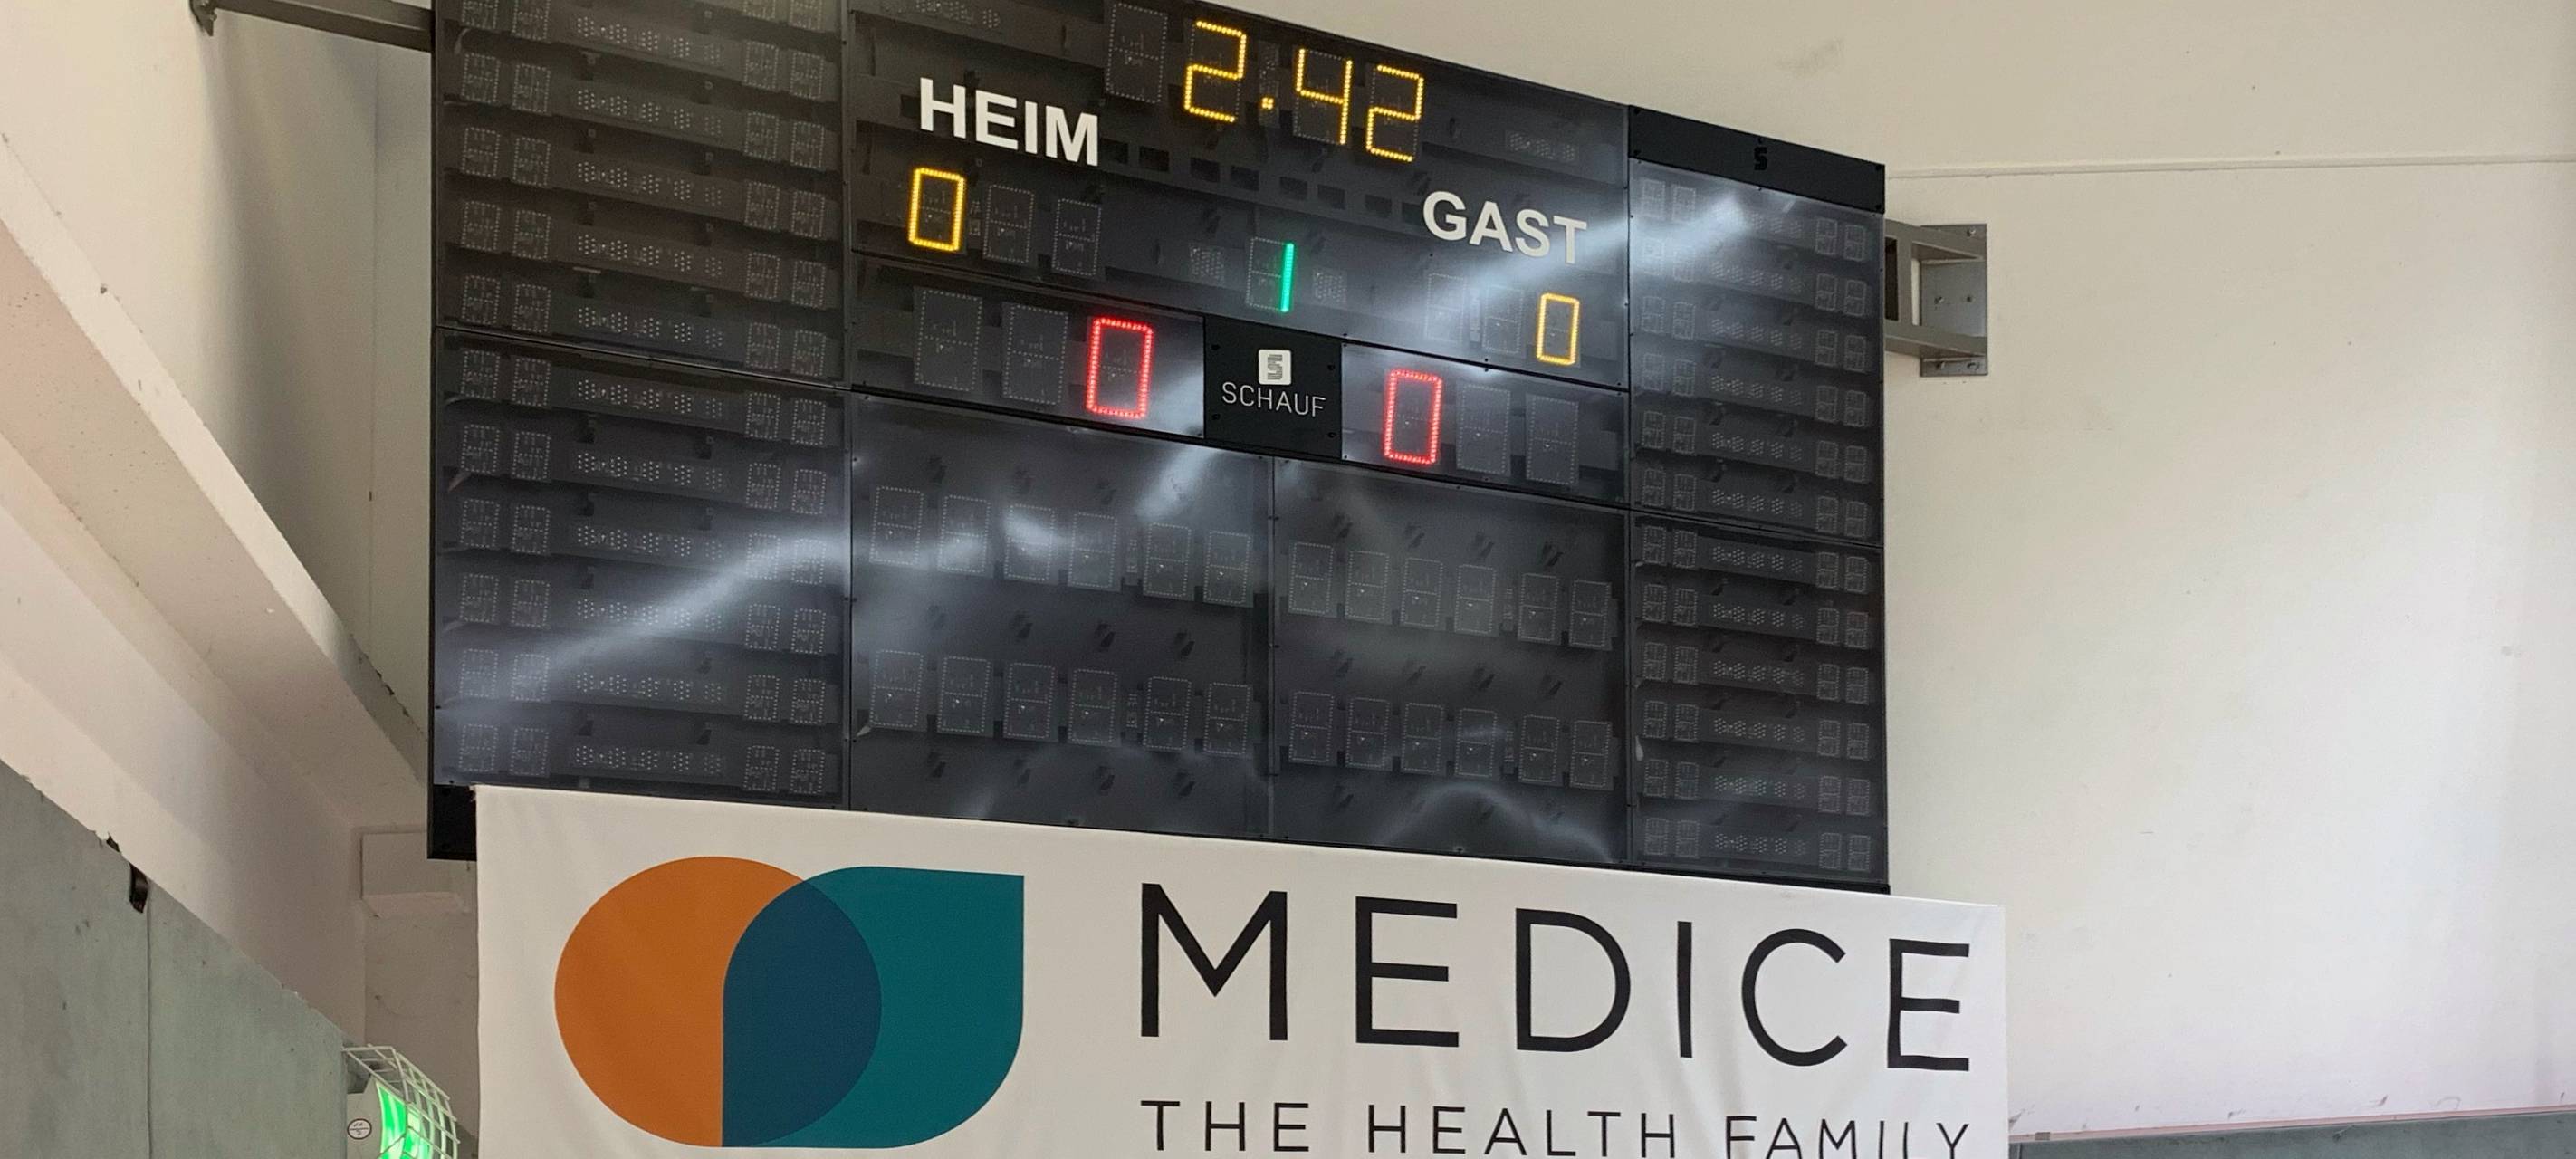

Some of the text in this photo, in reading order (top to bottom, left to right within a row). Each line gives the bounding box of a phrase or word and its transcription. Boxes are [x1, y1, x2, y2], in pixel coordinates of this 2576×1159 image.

[918, 78, 1099, 167] HEIM
[907, 167, 966, 253] 0
[1422, 191, 1587, 264] GAST
[1279, 241, 1295, 314] 1
[1086, 317, 1154, 419] 0
[1536, 292, 1580, 367] 0
[1221, 381, 1326, 417] SCHAUF
[1383, 369, 1443, 465] 0
[1140, 883, 1970, 1072] MEDICE
[1140, 1100, 1970, 1159] THE HEALTH FAMILY
